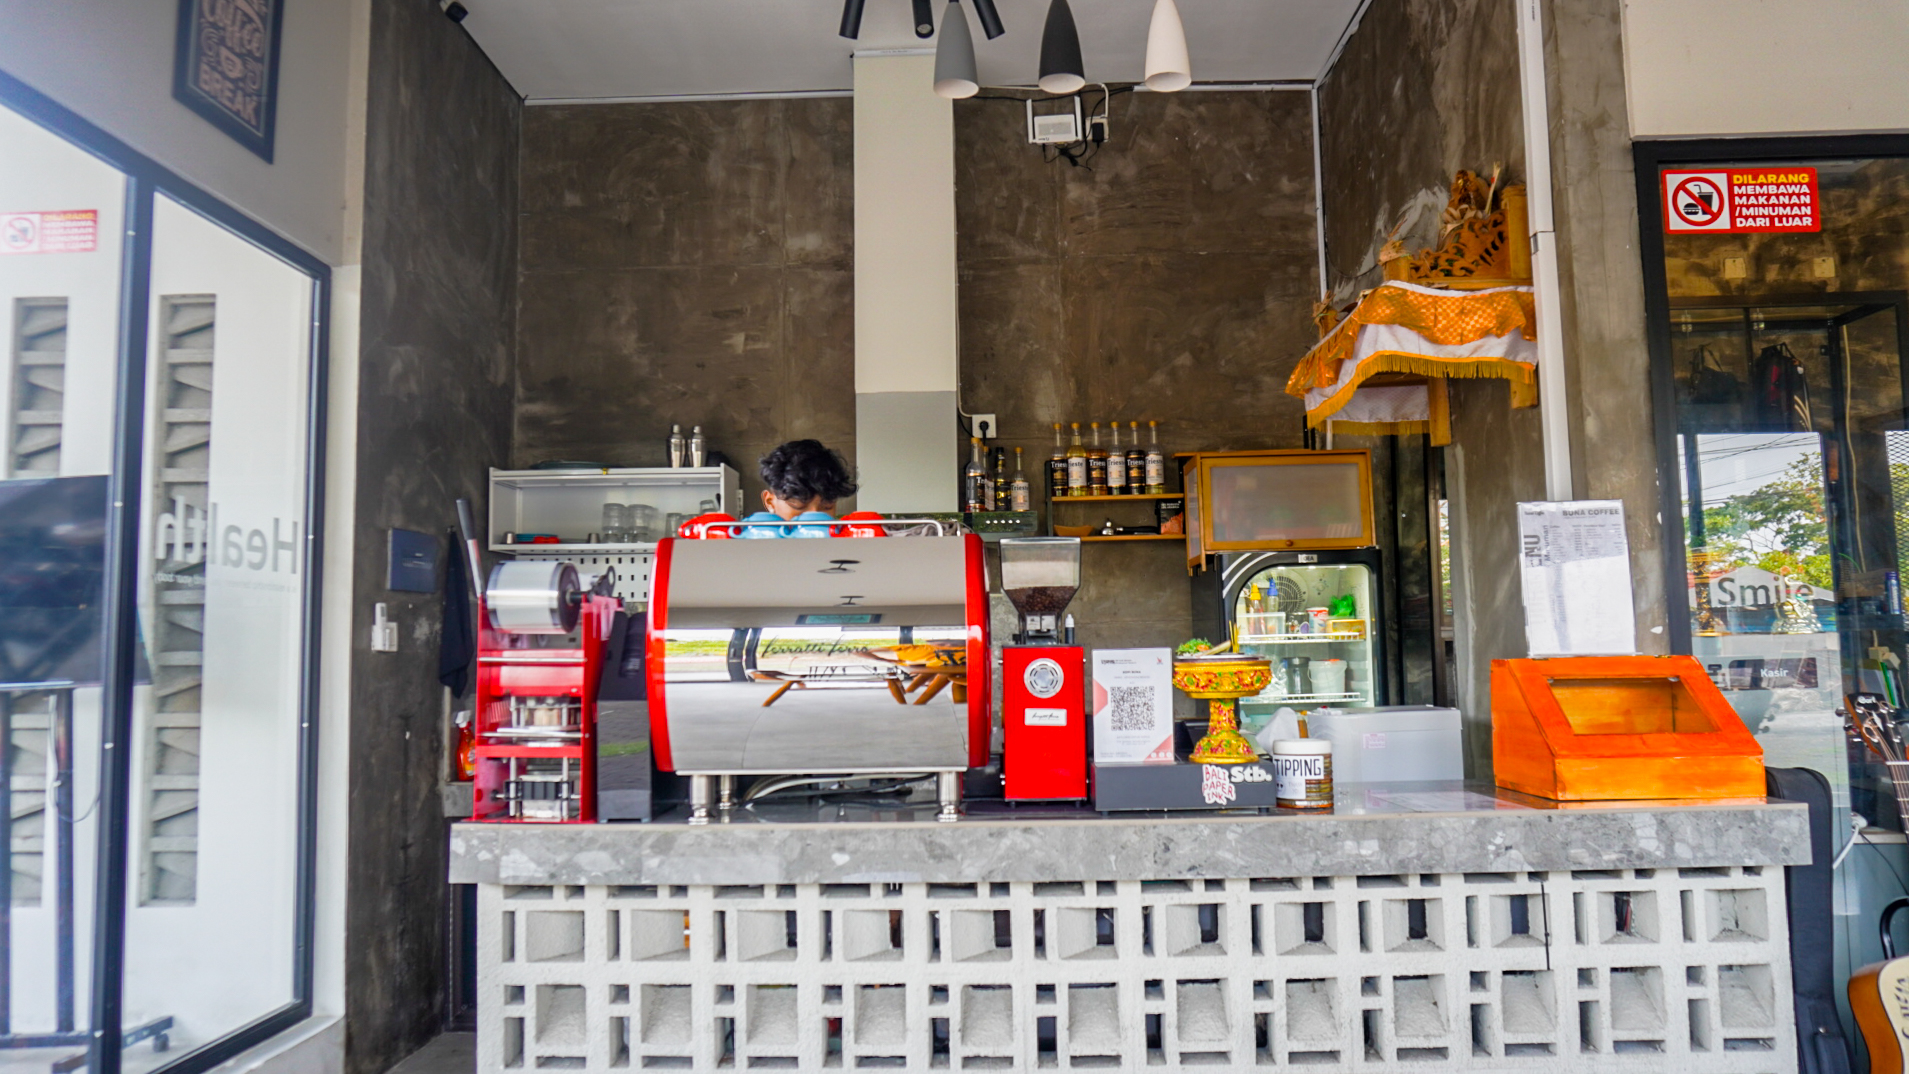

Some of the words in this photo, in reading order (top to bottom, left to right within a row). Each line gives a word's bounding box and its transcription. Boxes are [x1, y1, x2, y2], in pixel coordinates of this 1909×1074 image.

[200, 63, 258, 126] BREAK
[1732, 173, 1810, 185] DILARANG
[1733, 184, 1810, 195] MEMBAWA
[1734, 195, 1811, 205] MAKANAN
[1735, 206, 1812, 217] /MINUMAN
[1736, 217, 1770, 227] DARI
[1774, 216, 1813, 227] LUAR
[1588, 508, 1620, 516] COFFEE
[1760, 668, 1789, 678] Kasir
[1274, 758, 1322, 777] TIPPING
[1205, 766, 1226, 782] BALI
[1203, 781, 1234, 798] PAPER
[1207, 791, 1225, 803] INK
